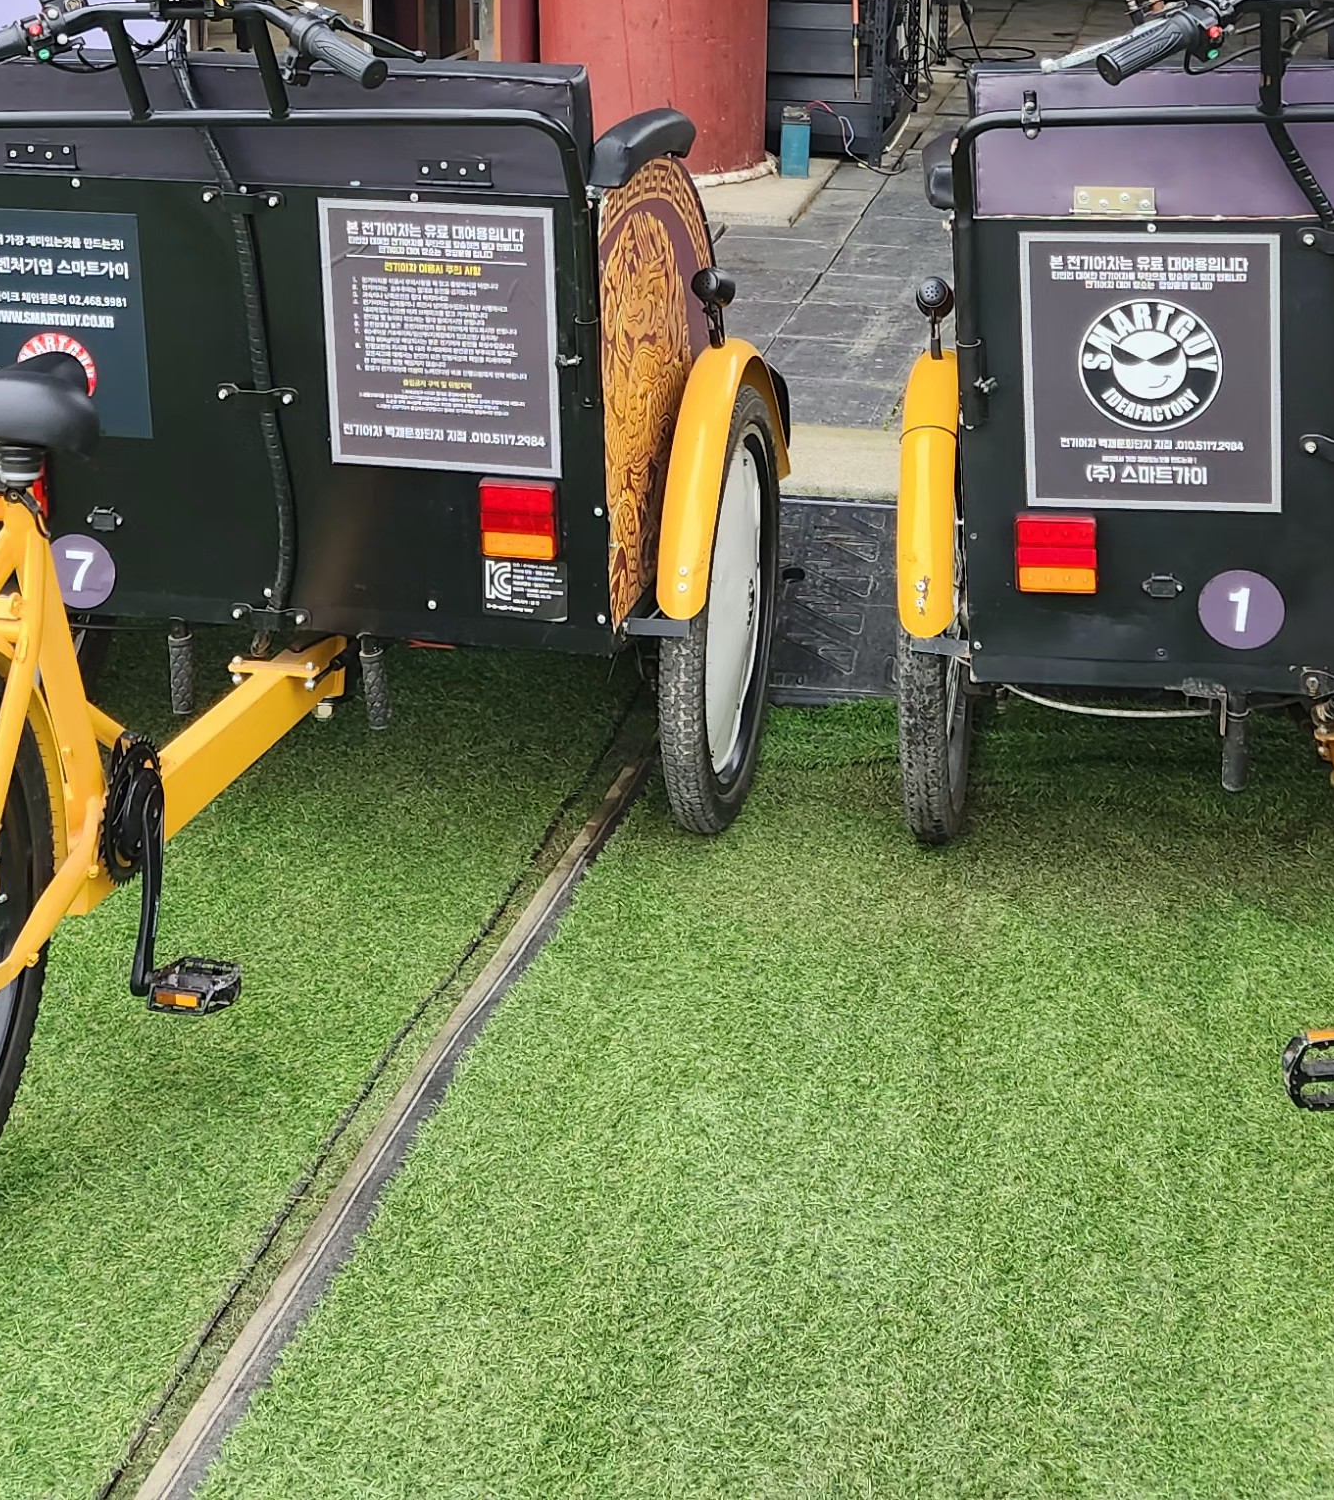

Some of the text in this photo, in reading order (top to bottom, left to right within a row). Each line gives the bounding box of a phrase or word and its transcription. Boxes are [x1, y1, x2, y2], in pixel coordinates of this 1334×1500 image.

[4, 233, 24, 246] 가장
[346, 220, 524, 242] 본 전기어차는 유료 대여용입니다
[56, 259, 129, 279] 스마트가이
[1049, 255, 1248, 272] 본 전기어차는 유료 대여용입니다
[1083, 303, 1218, 373] SMARTGUY
[1101, 387, 1201, 423] IDEAFACTORY
[343, 422, 382, 437] 전기어차
[384, 425, 444, 441] 백제문화단지
[446, 428, 466, 442] 지점
[1085, 464, 1207, 485] (주) 스마트가이
[65, 549, 94, 592] 7
[1229, 587, 1251, 633] 1
